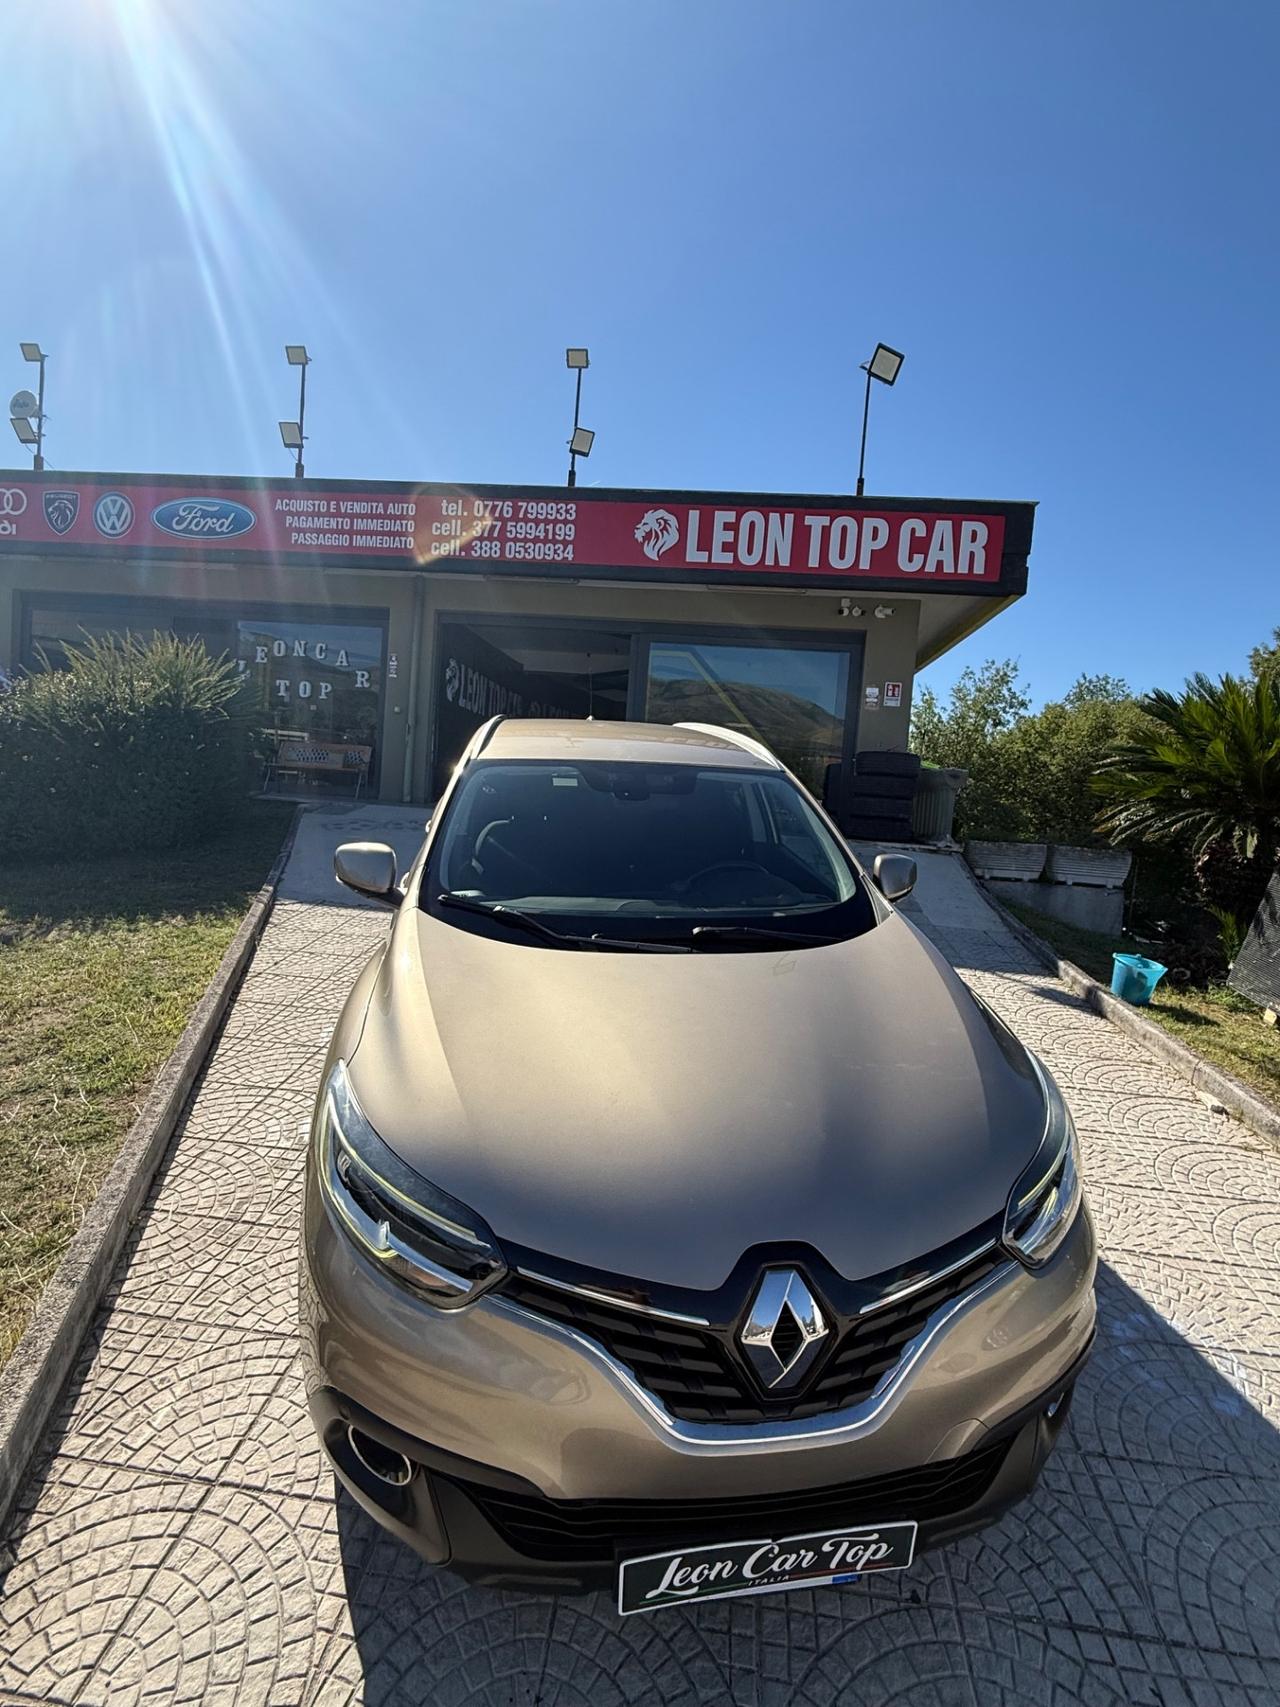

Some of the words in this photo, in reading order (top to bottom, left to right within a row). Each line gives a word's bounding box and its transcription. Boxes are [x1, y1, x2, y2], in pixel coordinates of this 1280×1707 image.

[275, 498, 327, 513] ACQUISTO
[330, 500, 337, 513] E
[340, 501, 384, 515] VENDITA
[387, 502, 416, 516] AUTO
[441, 500, 468, 517] tel.
[473, 501, 513, 518] 0776
[517, 502, 576, 520] 799933
[172, 503, 236, 534] Ford
[286, 515, 350, 530] PAGAMENTO
[353, 518, 415, 532] IMMEDIATO
[432, 519, 467, 537] cell.
[473, 521, 503, 538] 377
[506, 522, 576, 541] 5994199
[291, 532, 349, 546] PASSAGGIO
[352, 534, 414, 549] IMMEDIATO
[430, 540, 465, 557] cell.
[471, 541, 501, 558] 388
[505, 541, 575, 561] 0530934
[685, 509, 794, 567] LEON
[804, 515, 889, 570] TOP
[897, 518, 989, 575] CAR
[275, 679, 333, 699] TOP
[645, 1557, 738, 1596] Leon
[742, 1544, 818, 1578] Car
[822, 1533, 894, 1570] Top
[748, 1575, 790, 1586] ITALIA
